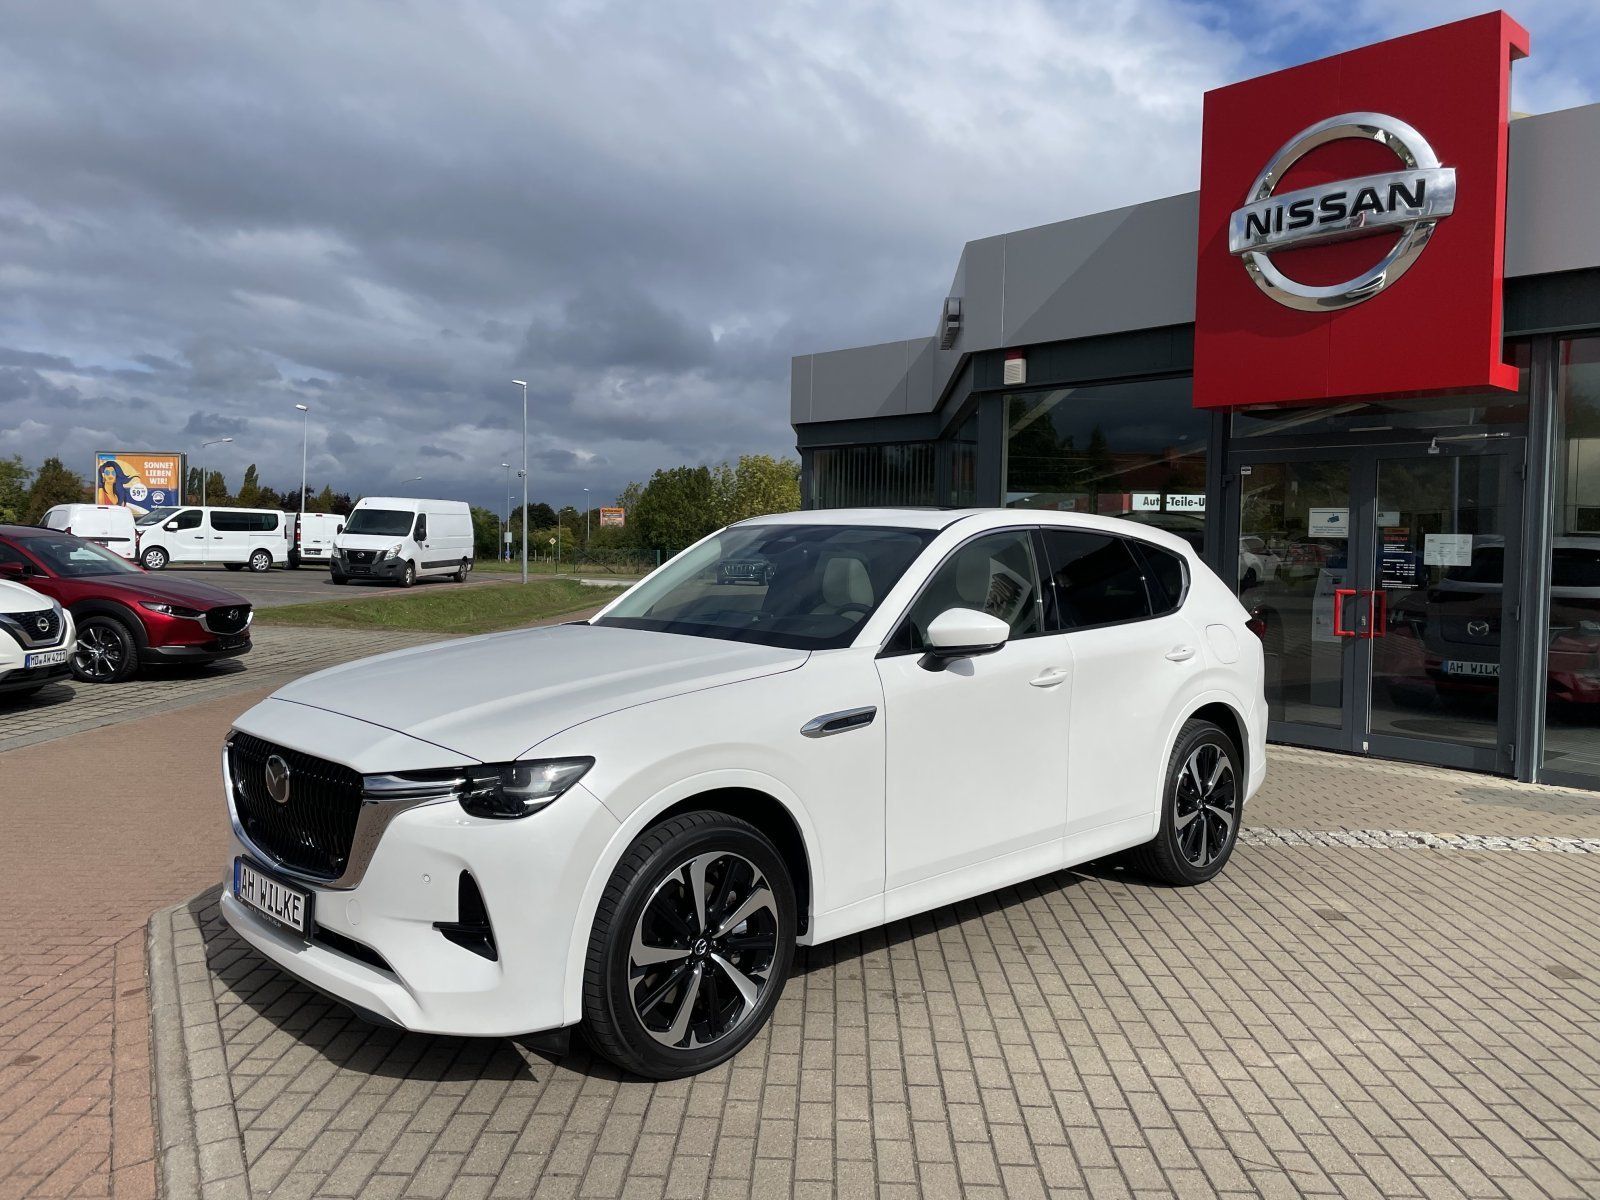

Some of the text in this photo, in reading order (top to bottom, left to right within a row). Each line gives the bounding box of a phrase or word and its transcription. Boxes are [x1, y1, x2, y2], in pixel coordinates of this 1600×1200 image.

[1246, 178, 1426, 240] NISSAN
[144, 461, 173, 469] SONNE?
[145, 469, 171, 477] LIEBEN
[1449, 661, 1464, 672] AH
[242, 868, 255, 900] AH
[261, 878, 301, 926] WILKE
